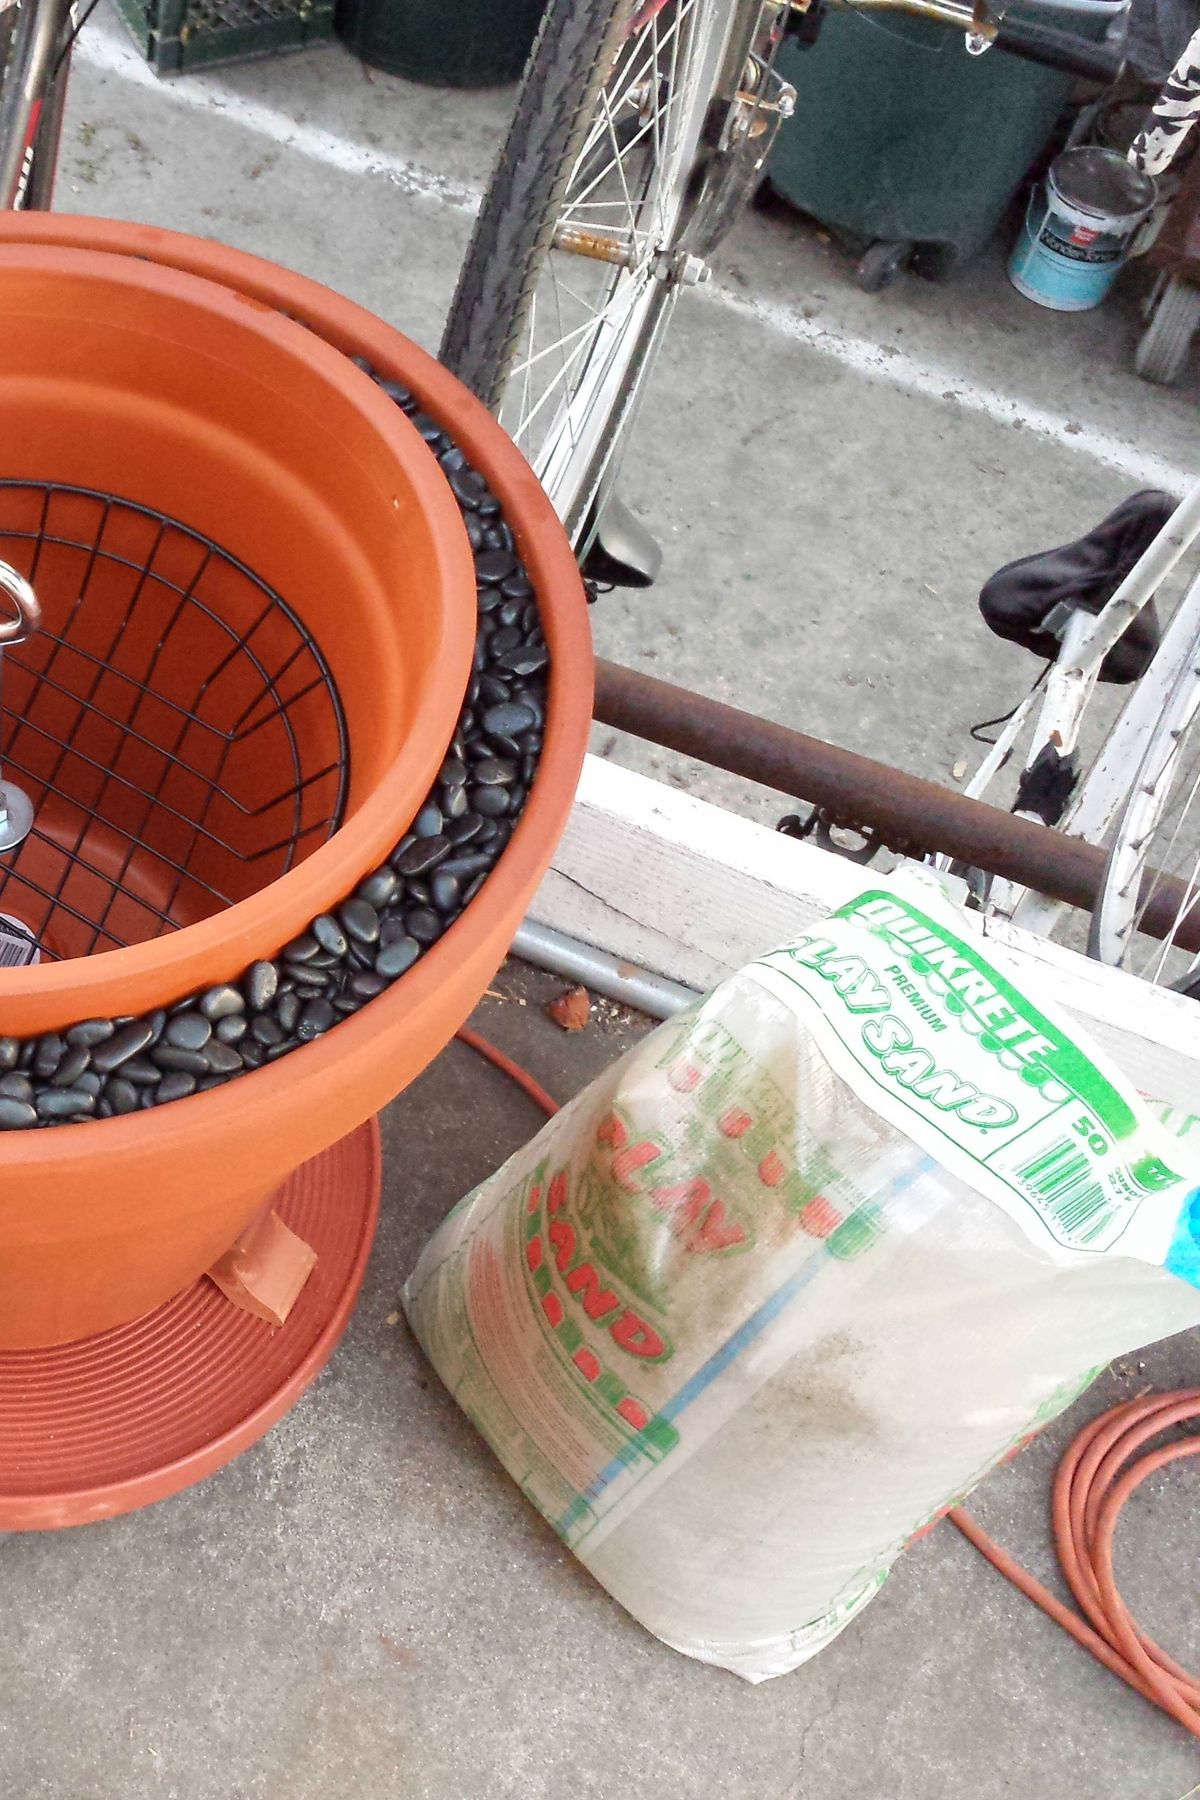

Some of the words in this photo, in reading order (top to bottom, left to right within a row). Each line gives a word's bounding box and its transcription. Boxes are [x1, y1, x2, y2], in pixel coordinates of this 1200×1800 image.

[849, 898, 1058, 1066] QUIKRETE
[883, 965, 948, 1033] PREMIUM
[861, 1014, 1019, 1129] SAND
[1071, 1115, 1108, 1156] 50
